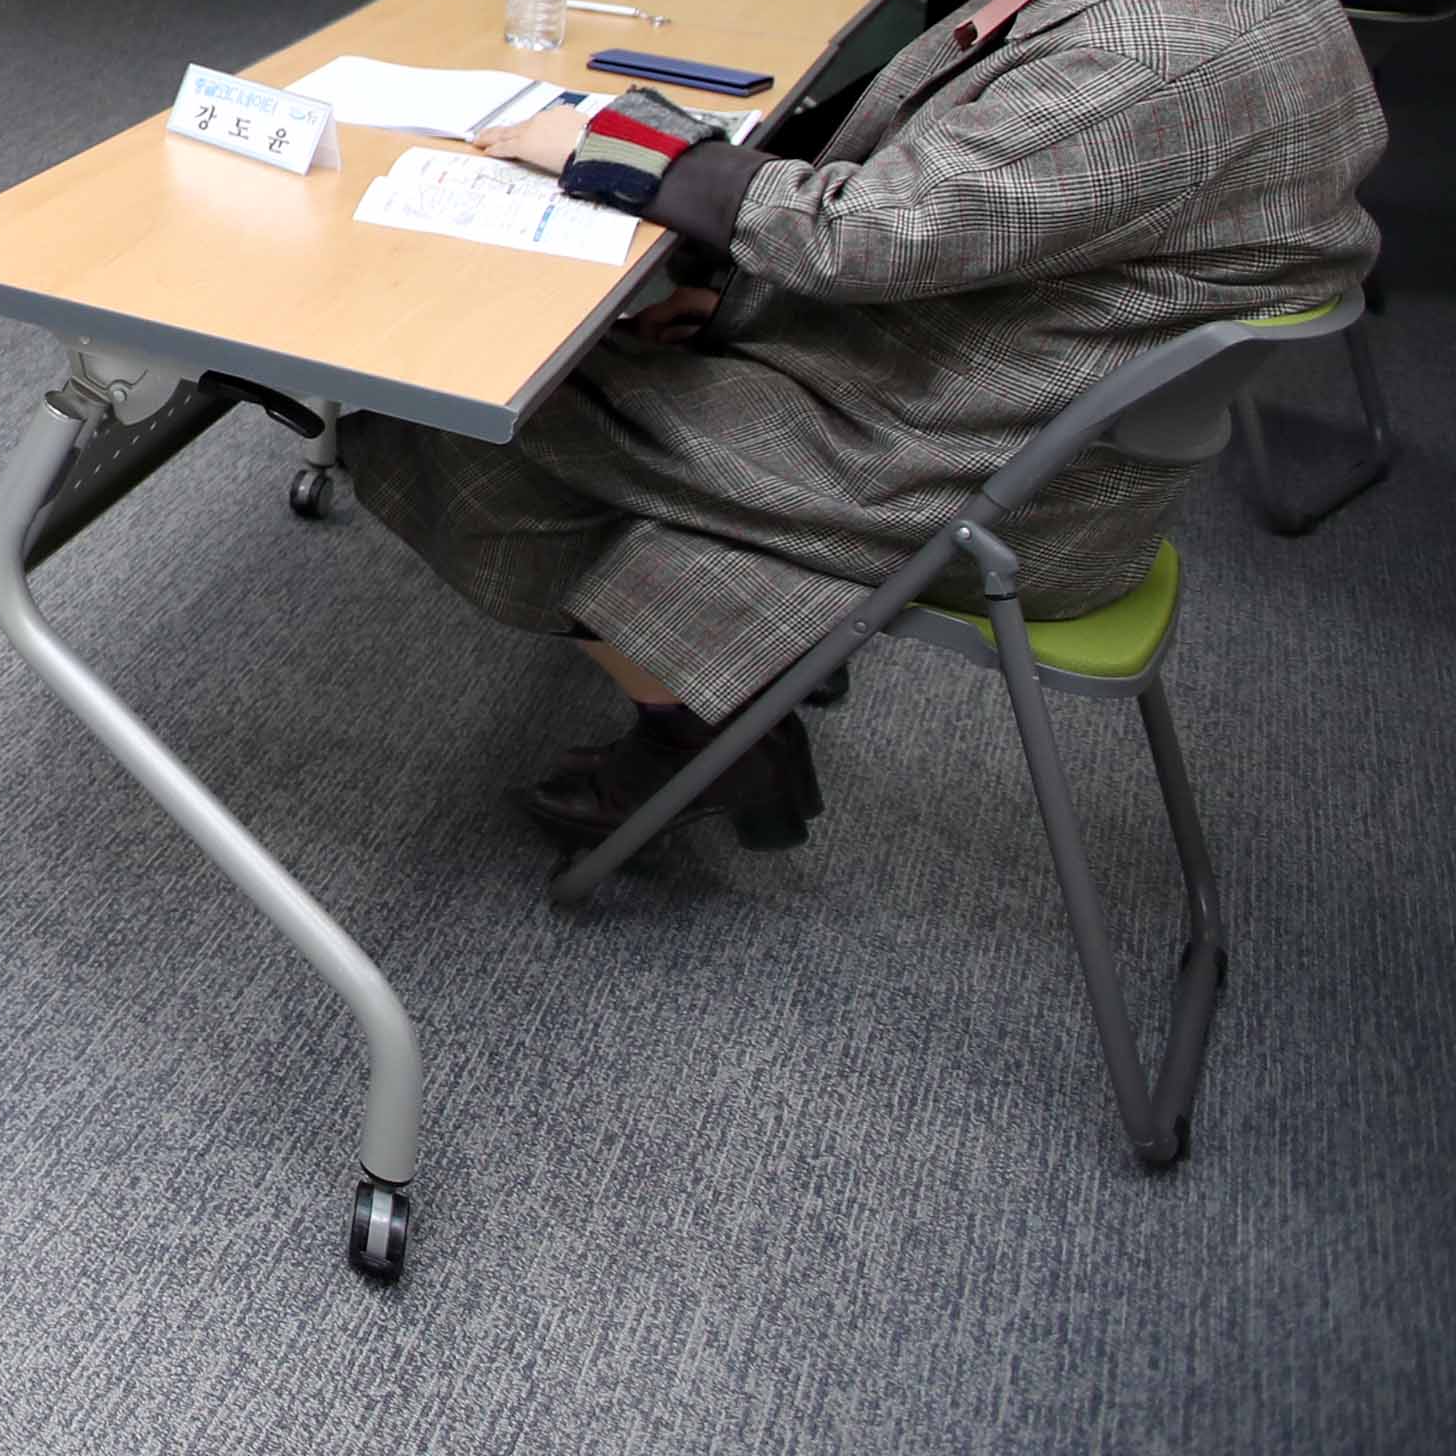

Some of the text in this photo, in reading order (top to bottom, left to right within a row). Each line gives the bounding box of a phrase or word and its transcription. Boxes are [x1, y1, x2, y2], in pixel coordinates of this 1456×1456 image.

[193, 103, 292, 155] 강 도 윤
